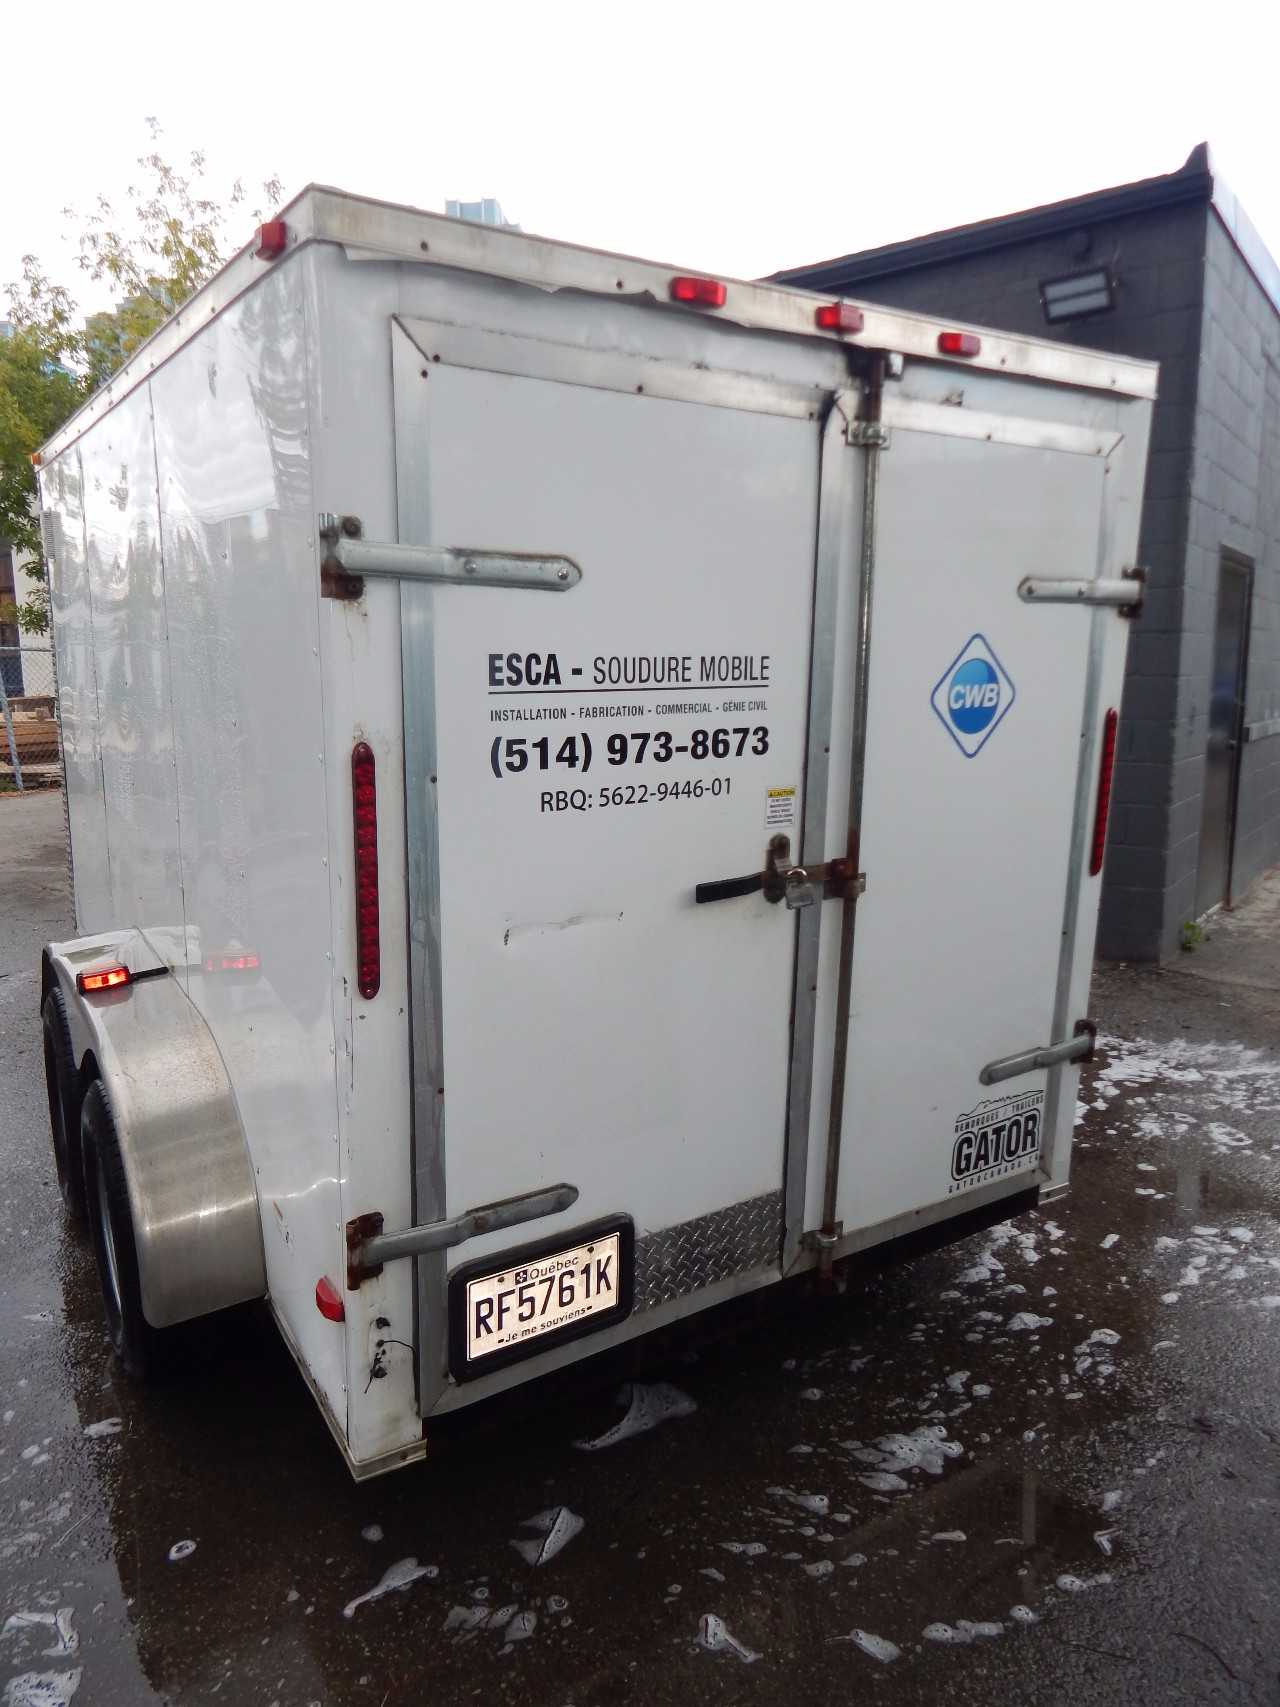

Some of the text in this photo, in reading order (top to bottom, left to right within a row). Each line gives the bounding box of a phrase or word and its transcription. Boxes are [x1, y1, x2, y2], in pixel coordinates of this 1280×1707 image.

[488, 653, 770, 686] ESCA - SOUDURE MOBILE
[490, 708, 567, 722] INSTALLATION
[579, 705, 644, 719] FABRICATION
[655, 703, 712, 715] COMMERCIAL
[747, 701, 768, 712] CIVIL
[950, 684, 998, 709] CWB
[490, 726, 769, 778] (514) 973-8673
[540, 777, 732, 812] RBQ: 5622-9446-01
[955, 1113, 1037, 1176] GATOR
[529, 1256, 579, 1279] Québec
[475, 1255, 612, 1339] RF5761K
[524, 1326, 537, 1336] me
[540, 1307, 586, 1331] souviens
